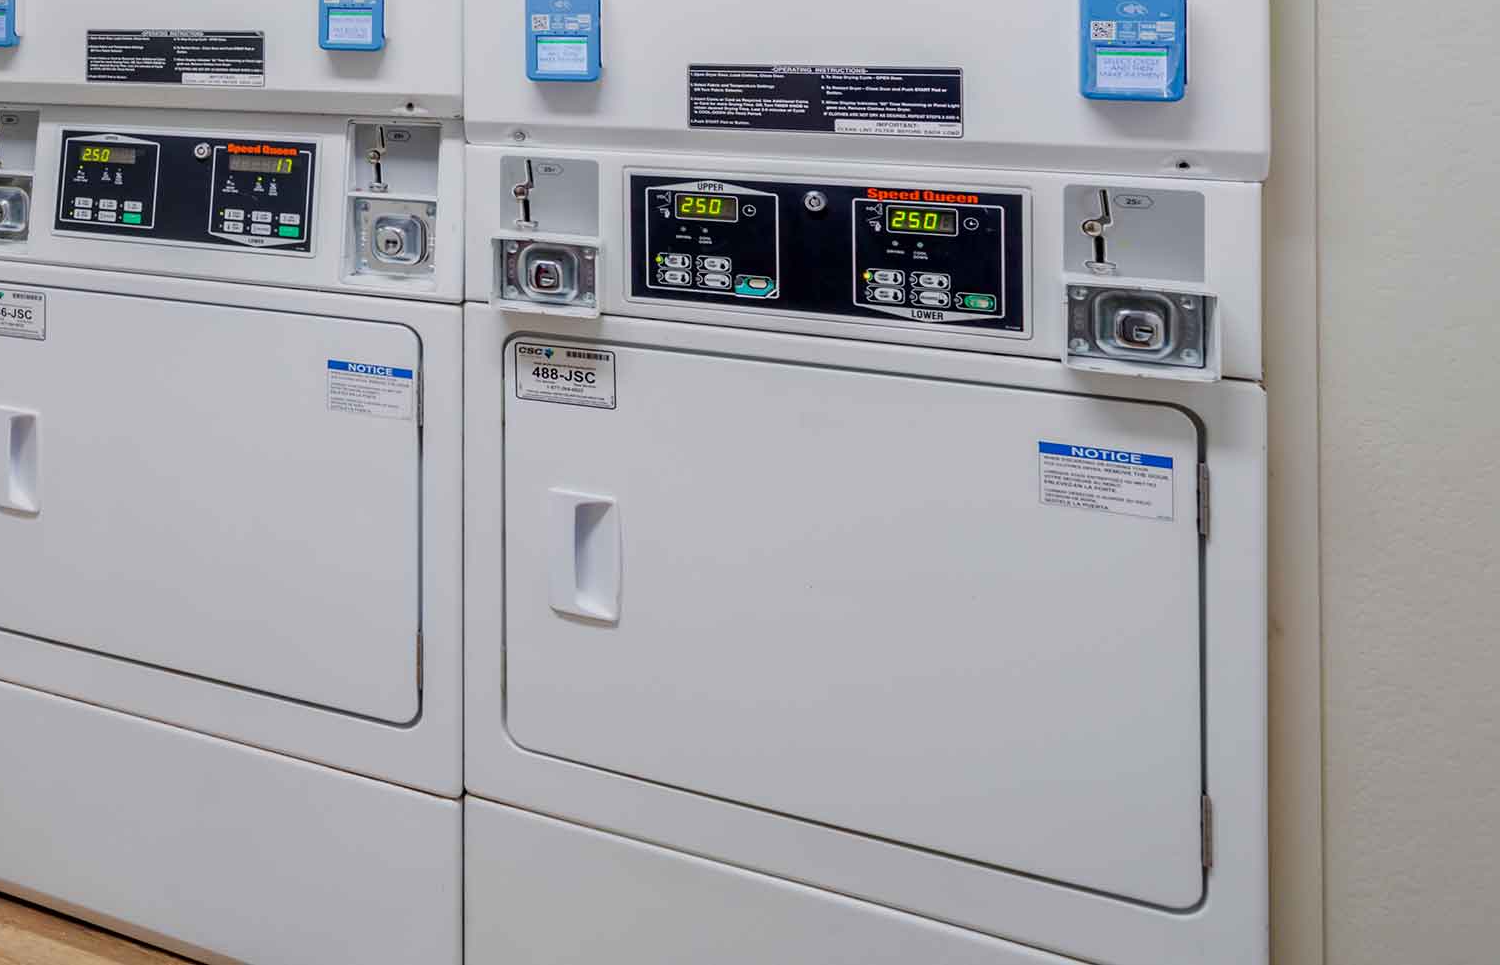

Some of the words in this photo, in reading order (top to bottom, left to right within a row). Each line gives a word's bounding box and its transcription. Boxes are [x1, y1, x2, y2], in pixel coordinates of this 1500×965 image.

[82, 147, 111, 163] 250
[227, 143, 260, 154] Speed
[262, 145, 298, 155] Queen
[276, 158, 293, 173] 17
[697, 182, 724, 191] UPPER
[867, 188, 920, 202] Speed
[922, 190, 979, 204] Queen
[681, 197, 722, 215] 250
[891, 211, 938, 230] 250
[911, 309, 944, 321] LOWER
[518, 346, 543, 356] CSC
[347, 363, 393, 376] NOTICE
[531, 366, 596, 384] 488-JSC
[1071, 446, 1143, 464] NOTICE
